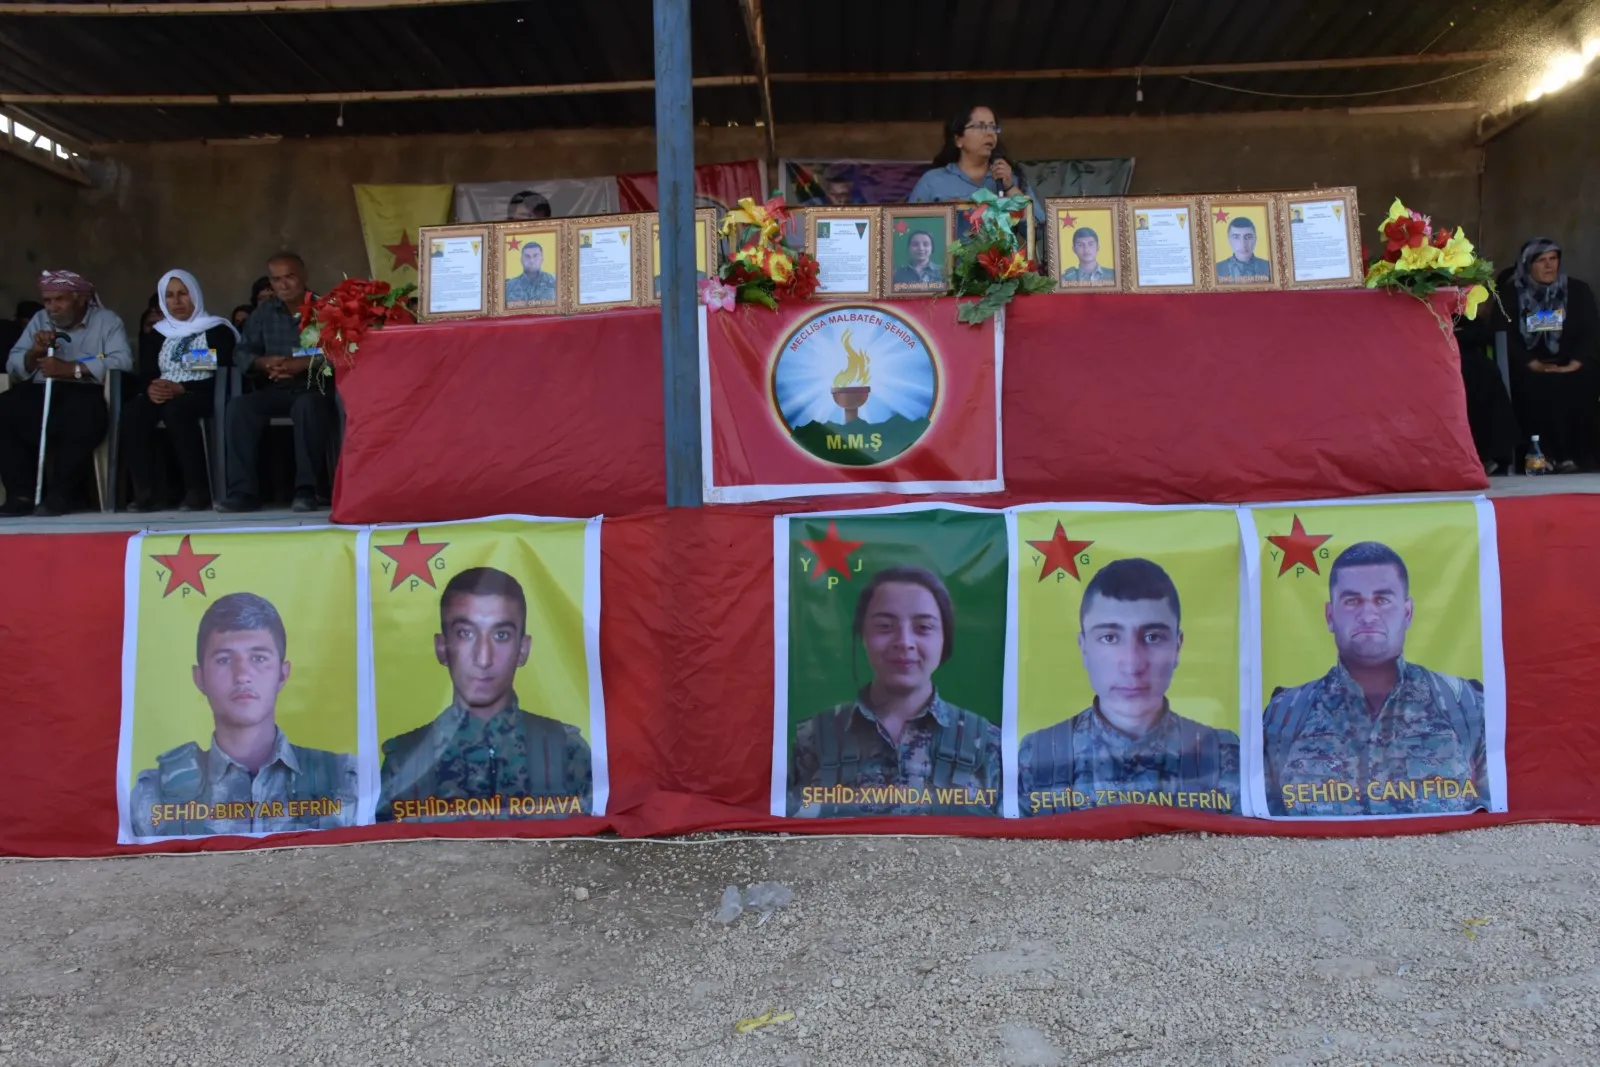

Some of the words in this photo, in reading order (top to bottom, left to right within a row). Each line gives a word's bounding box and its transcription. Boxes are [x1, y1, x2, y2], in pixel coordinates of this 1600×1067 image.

[826, 433, 883, 452] M.M.Ş
[381, 562, 391, 574] Y
[410, 580, 419, 592] P
[435, 558, 446, 570] G
[800, 557, 812, 572] Y
[827, 577, 839, 590] P
[853, 559, 863, 572] J
[1032, 556, 1040, 567] Y
[1057, 572, 1065, 583] P
[1080, 553, 1090, 565] G
[1270, 550, 1279, 562] Y
[1296, 567, 1305, 578] P
[1319, 548, 1329, 560] G
[155, 570, 166, 582] Y
[182, 587, 190, 598] P
[205, 568, 216, 580] G
[288, 797, 341, 817] EFRÎN
[509, 795, 582, 815] ROJAVA
[936, 787, 997, 805] WELAT
[1030, 788, 1090, 814] ŞEHÎD:
[1177, 789, 1231, 810] EFRÎN
[1281, 779, 1360, 809] ŞEHÎD:
[1366, 780, 1416, 801] CAN
[1422, 776, 1478, 799] FÎDA
